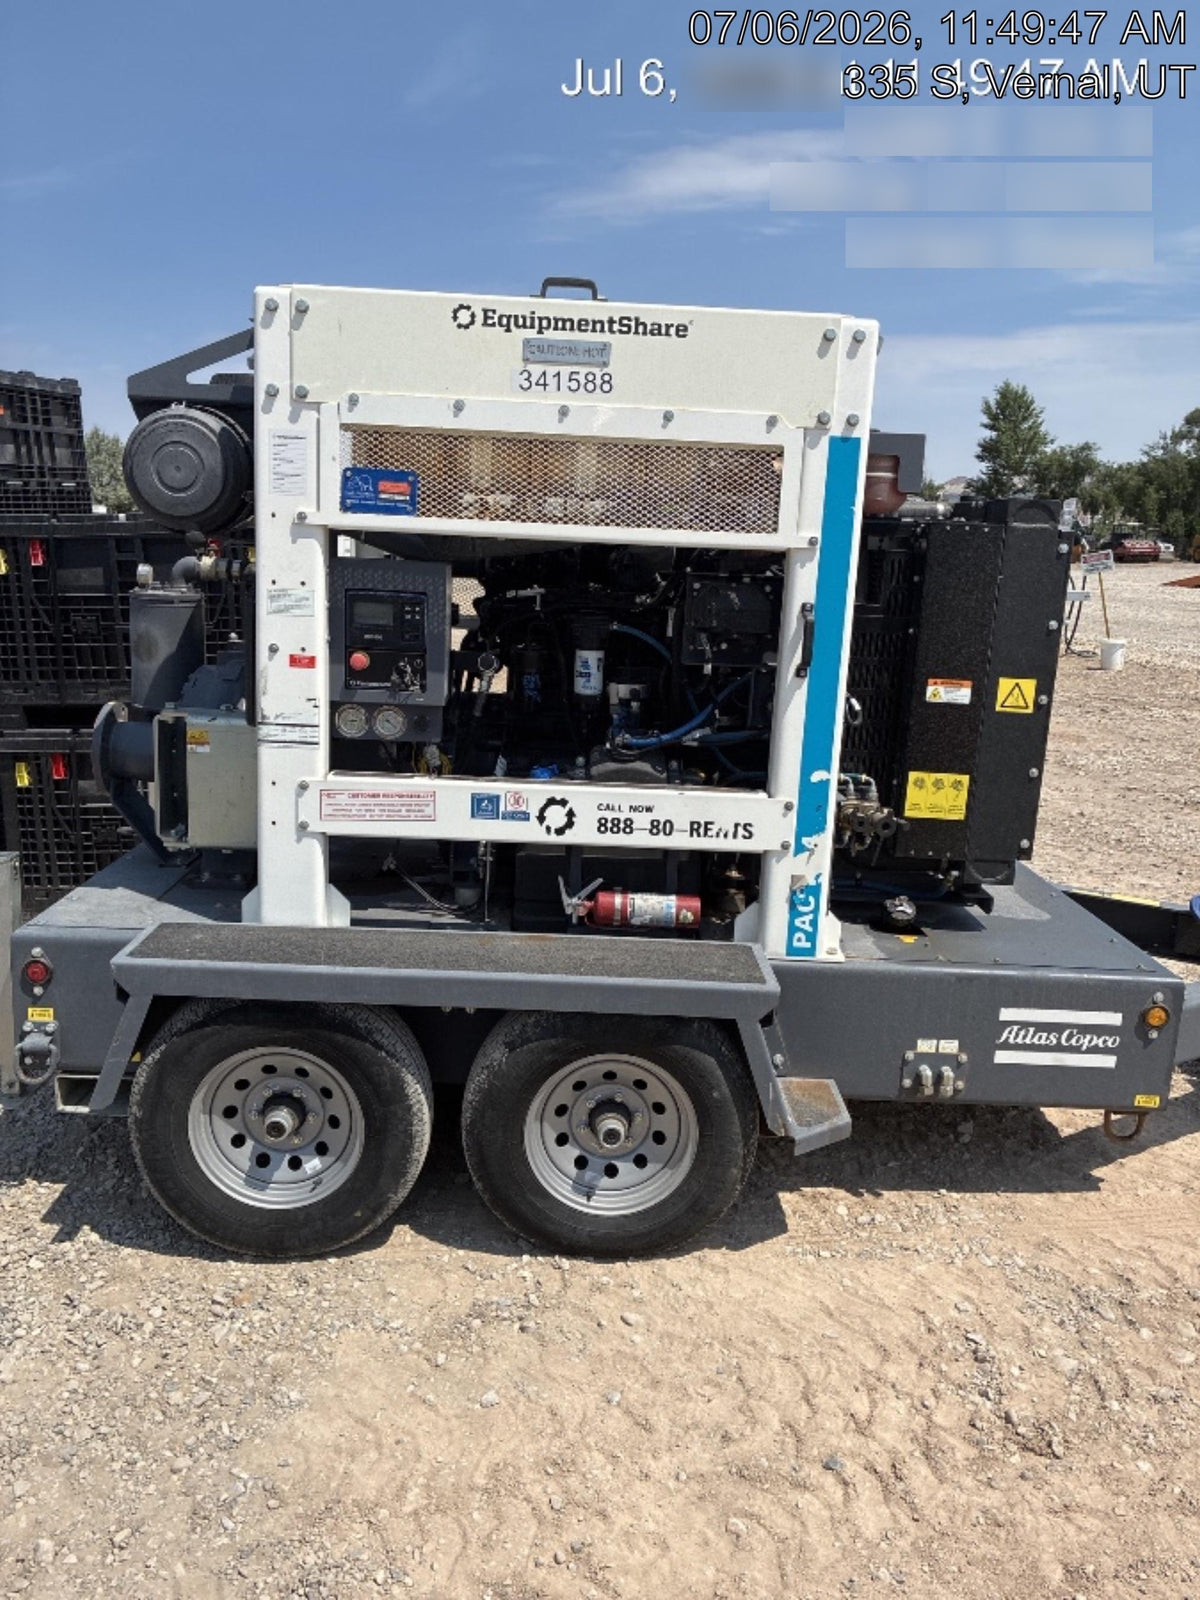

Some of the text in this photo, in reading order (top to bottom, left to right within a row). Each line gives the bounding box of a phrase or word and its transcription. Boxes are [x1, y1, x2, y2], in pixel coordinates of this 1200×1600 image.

[481, 308, 689, 338] EquipmentShare
[519, 369, 613, 394] 341588
[597, 803, 654, 813] CALL NOW
[996, 1025, 1120, 1051] Atlas Copco
